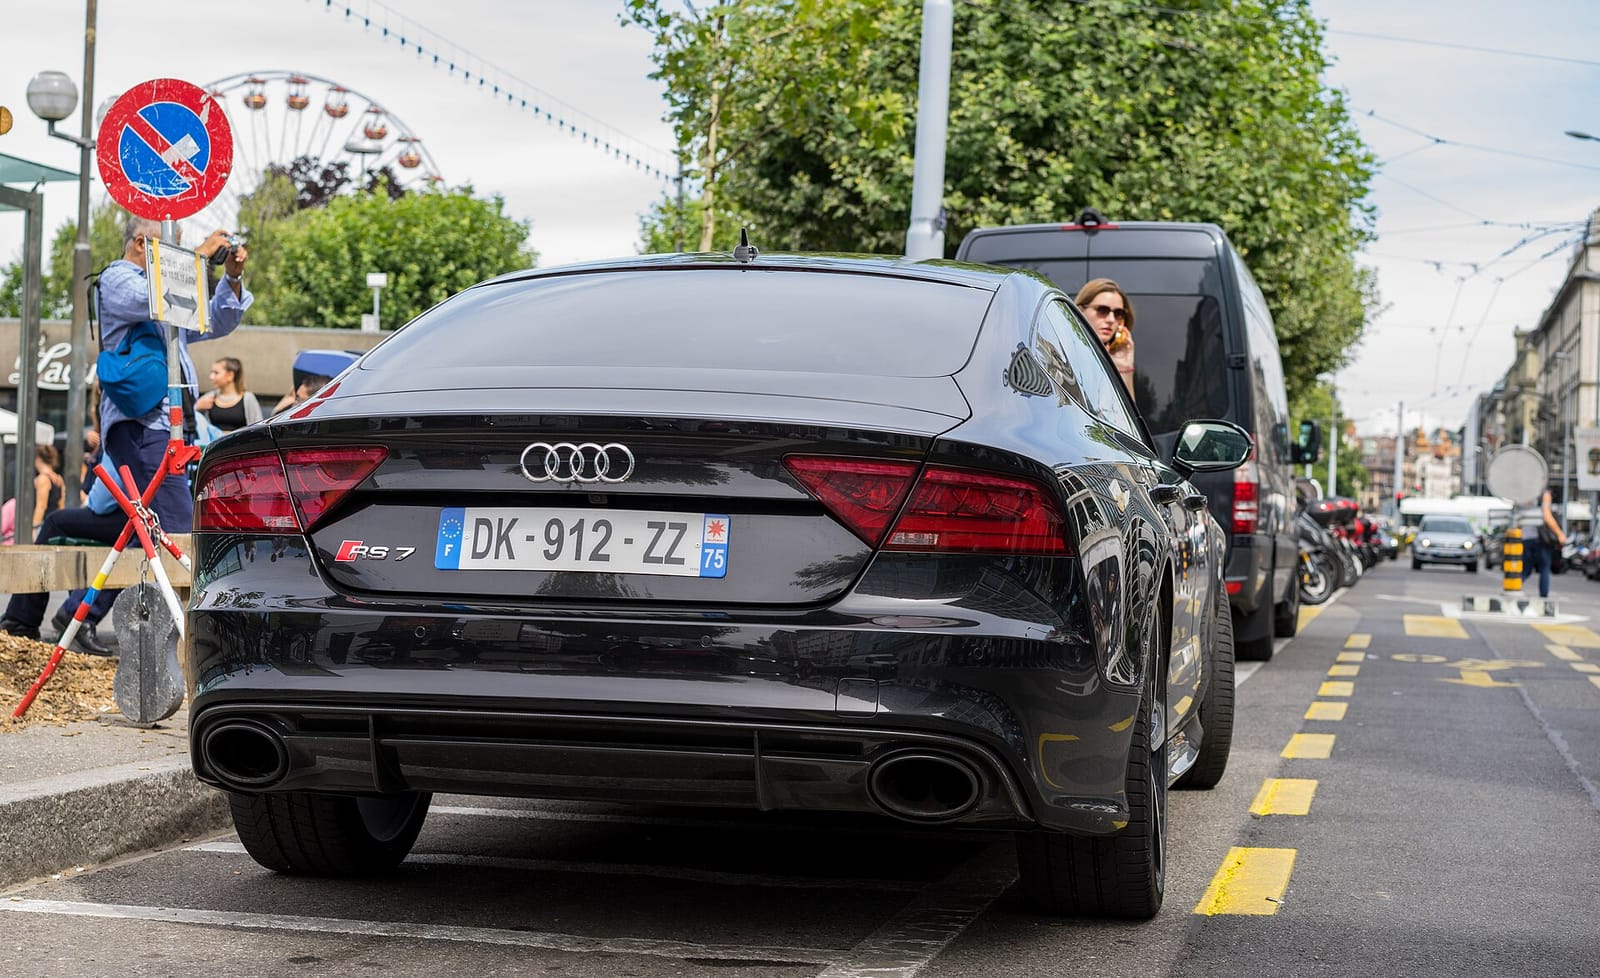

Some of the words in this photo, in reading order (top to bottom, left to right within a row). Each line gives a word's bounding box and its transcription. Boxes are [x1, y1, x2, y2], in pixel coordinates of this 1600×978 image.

[347, 545, 390, 560] RS
[395, 546, 417, 561] 7
[444, 544, 454, 557] F
[704, 548, 724, 569] 75
